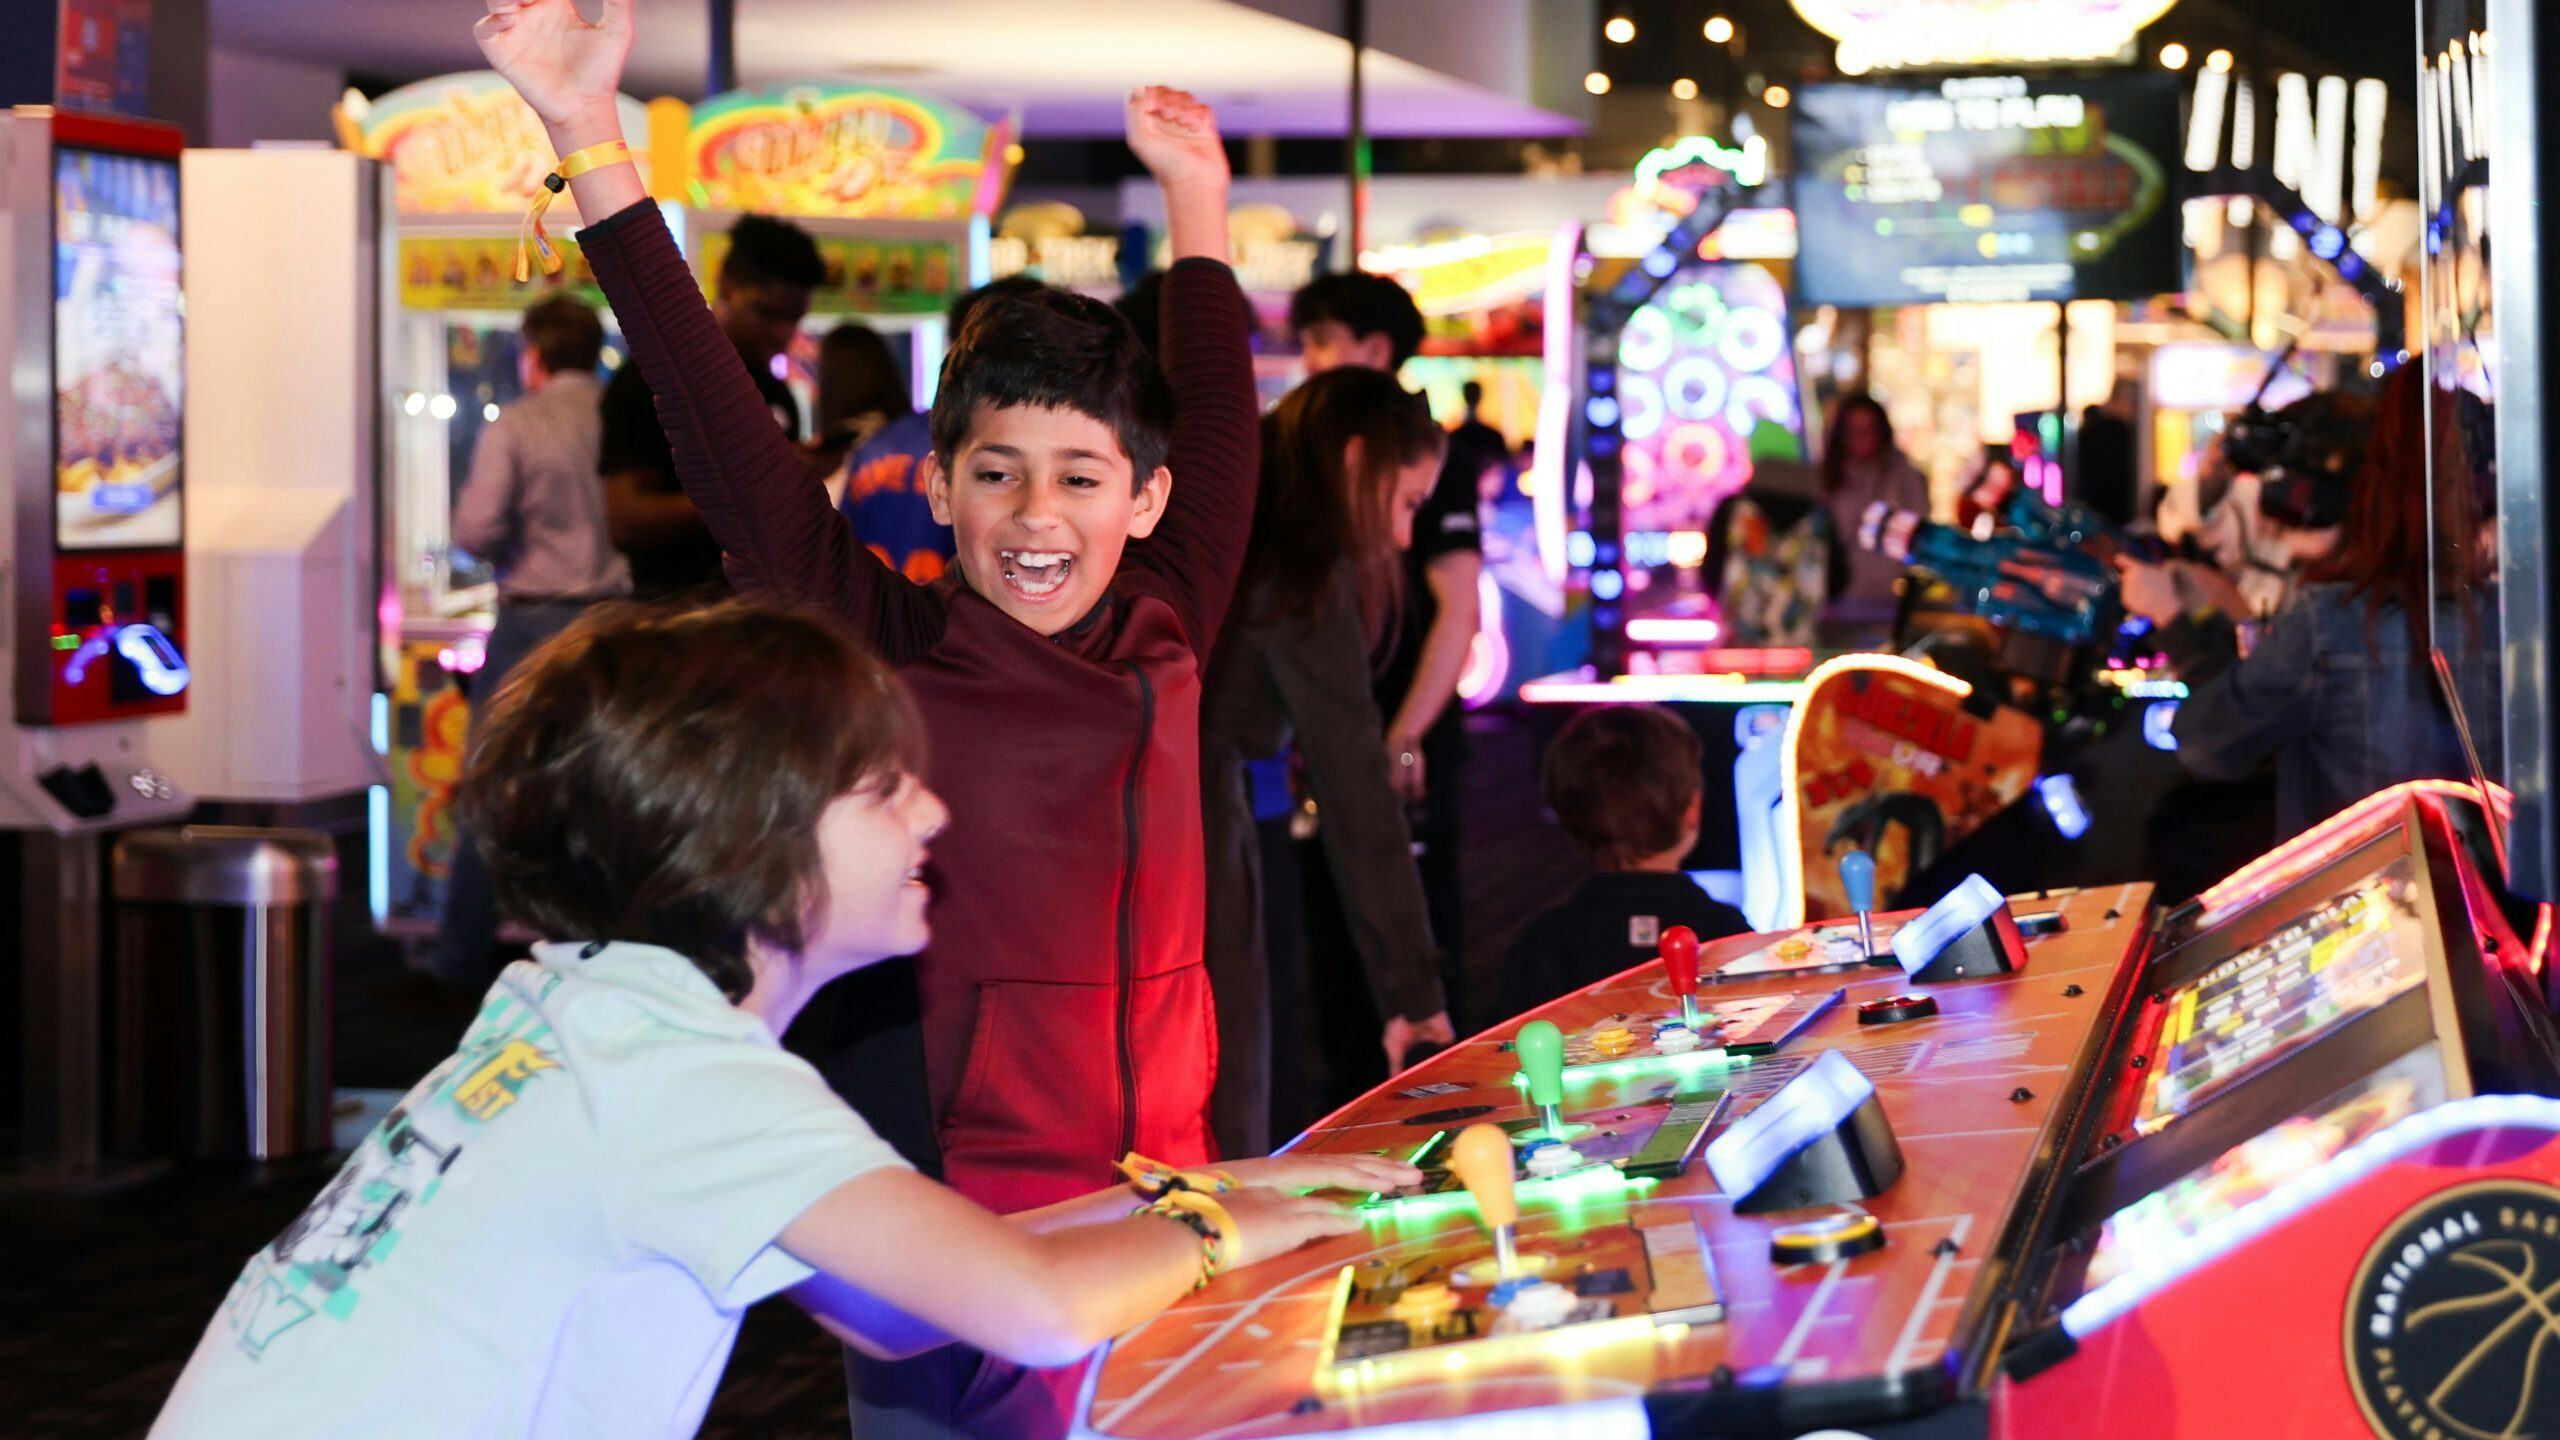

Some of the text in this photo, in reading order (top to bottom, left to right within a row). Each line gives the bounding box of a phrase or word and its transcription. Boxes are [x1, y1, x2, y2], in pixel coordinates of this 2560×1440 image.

[2369, 1205, 2560, 1338] NATIONAL BAS
[2374, 1347, 2455, 1440] PLAYER
